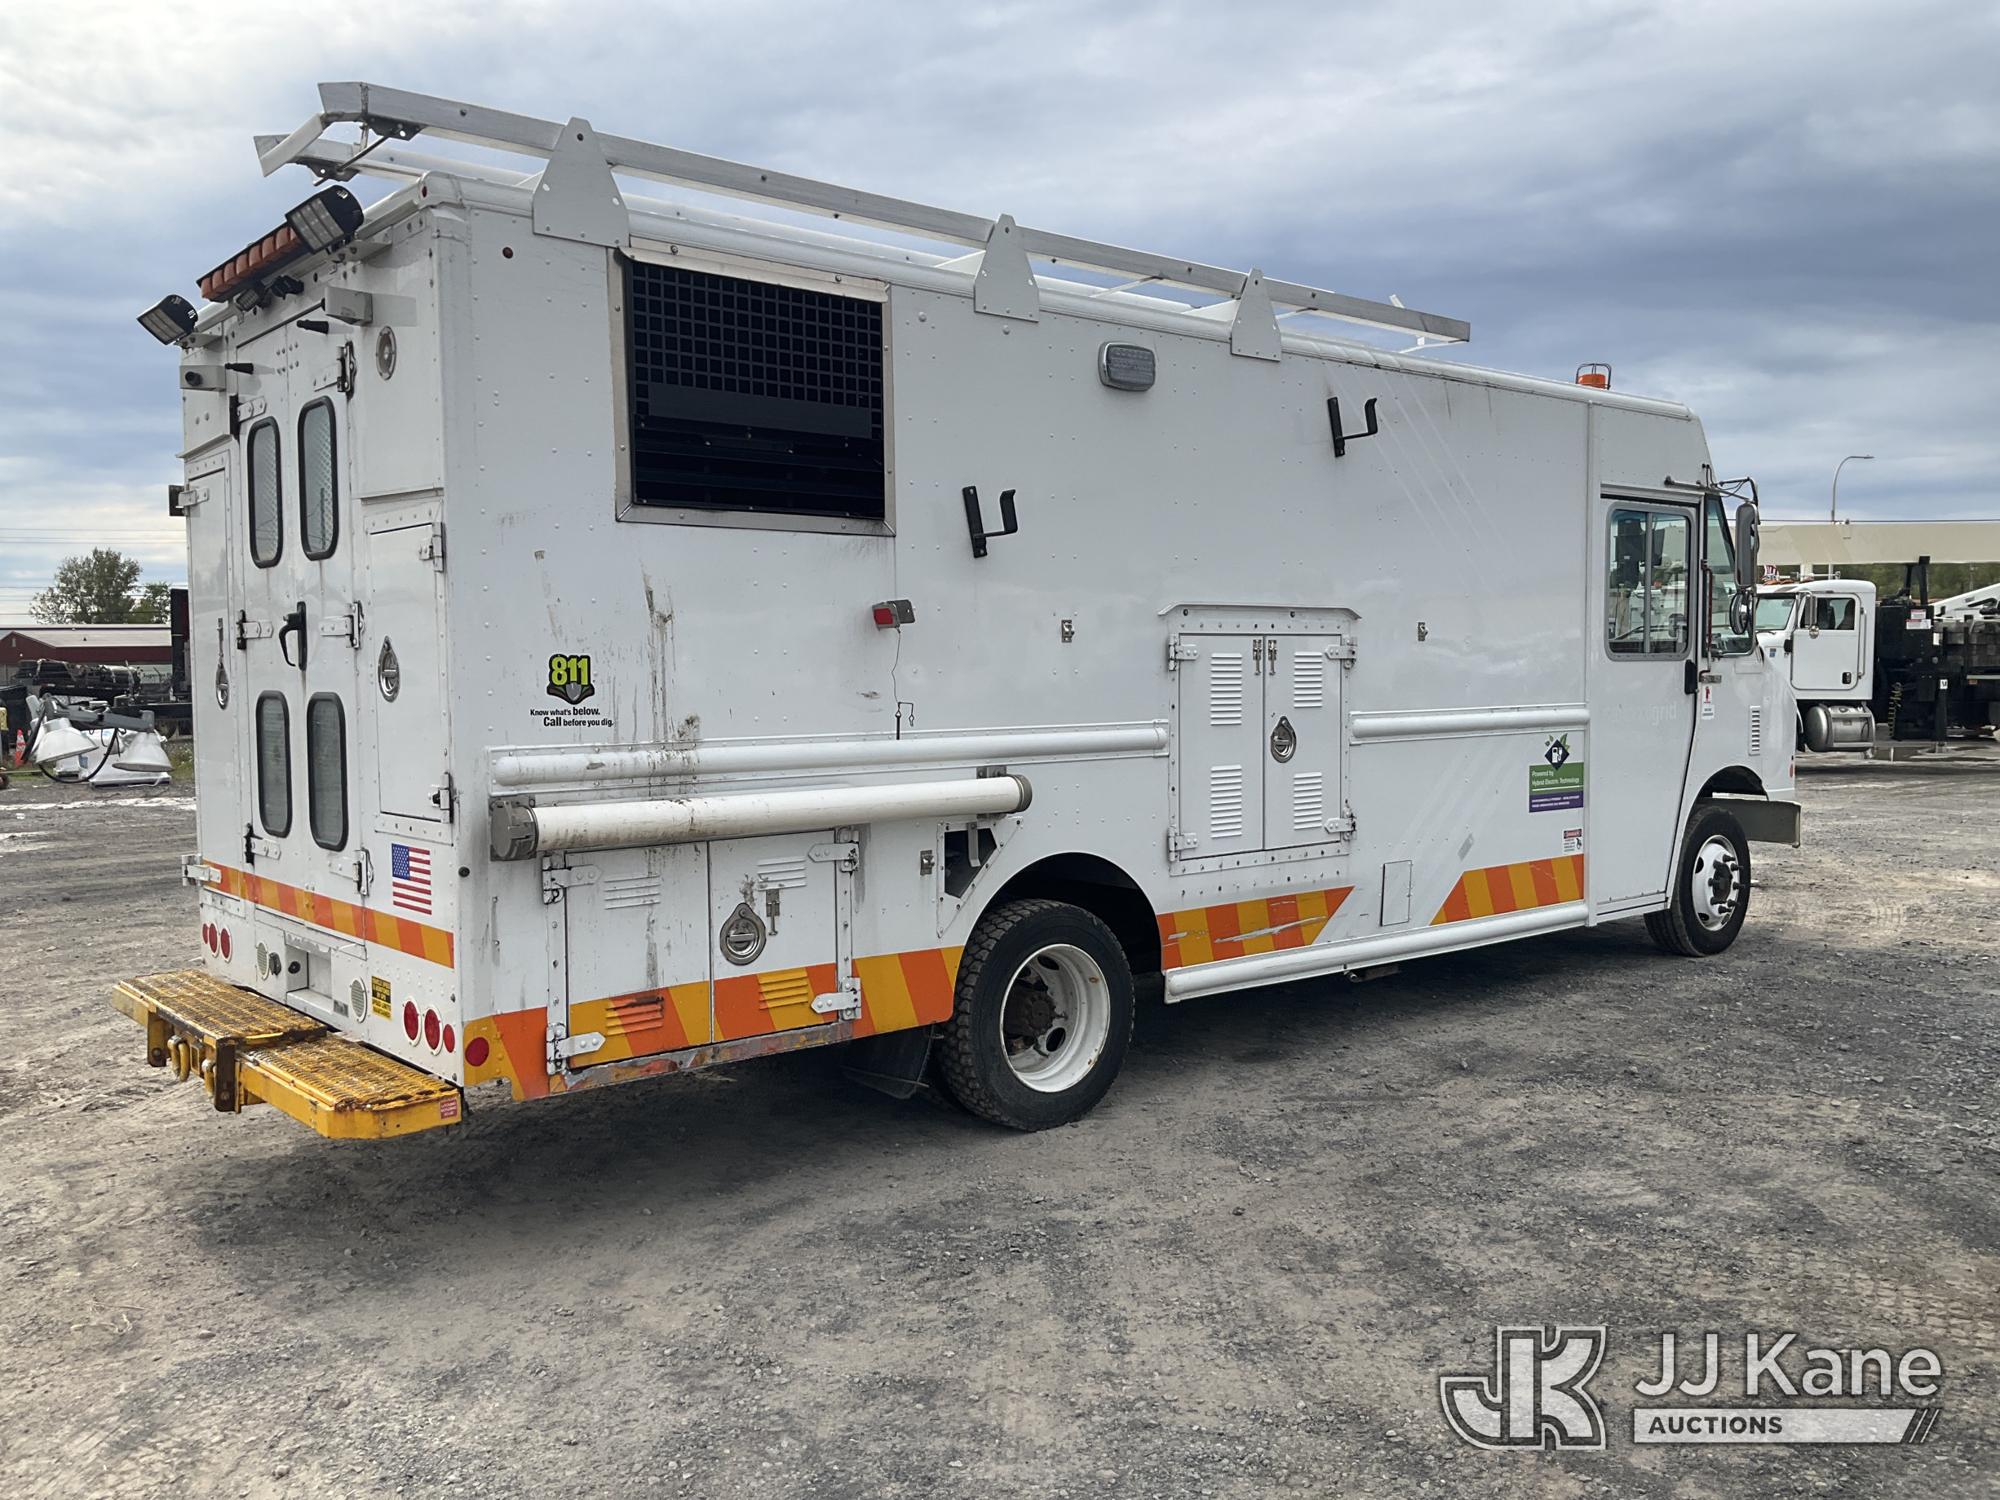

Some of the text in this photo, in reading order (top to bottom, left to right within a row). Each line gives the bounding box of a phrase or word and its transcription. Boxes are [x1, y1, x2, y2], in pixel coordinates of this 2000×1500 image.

[551, 656, 589, 686] 811
[573, 707, 600, 716] below.
[543, 717, 562, 727] Call
[587, 719, 600, 728] you
[601, 718, 614, 728] dig.
